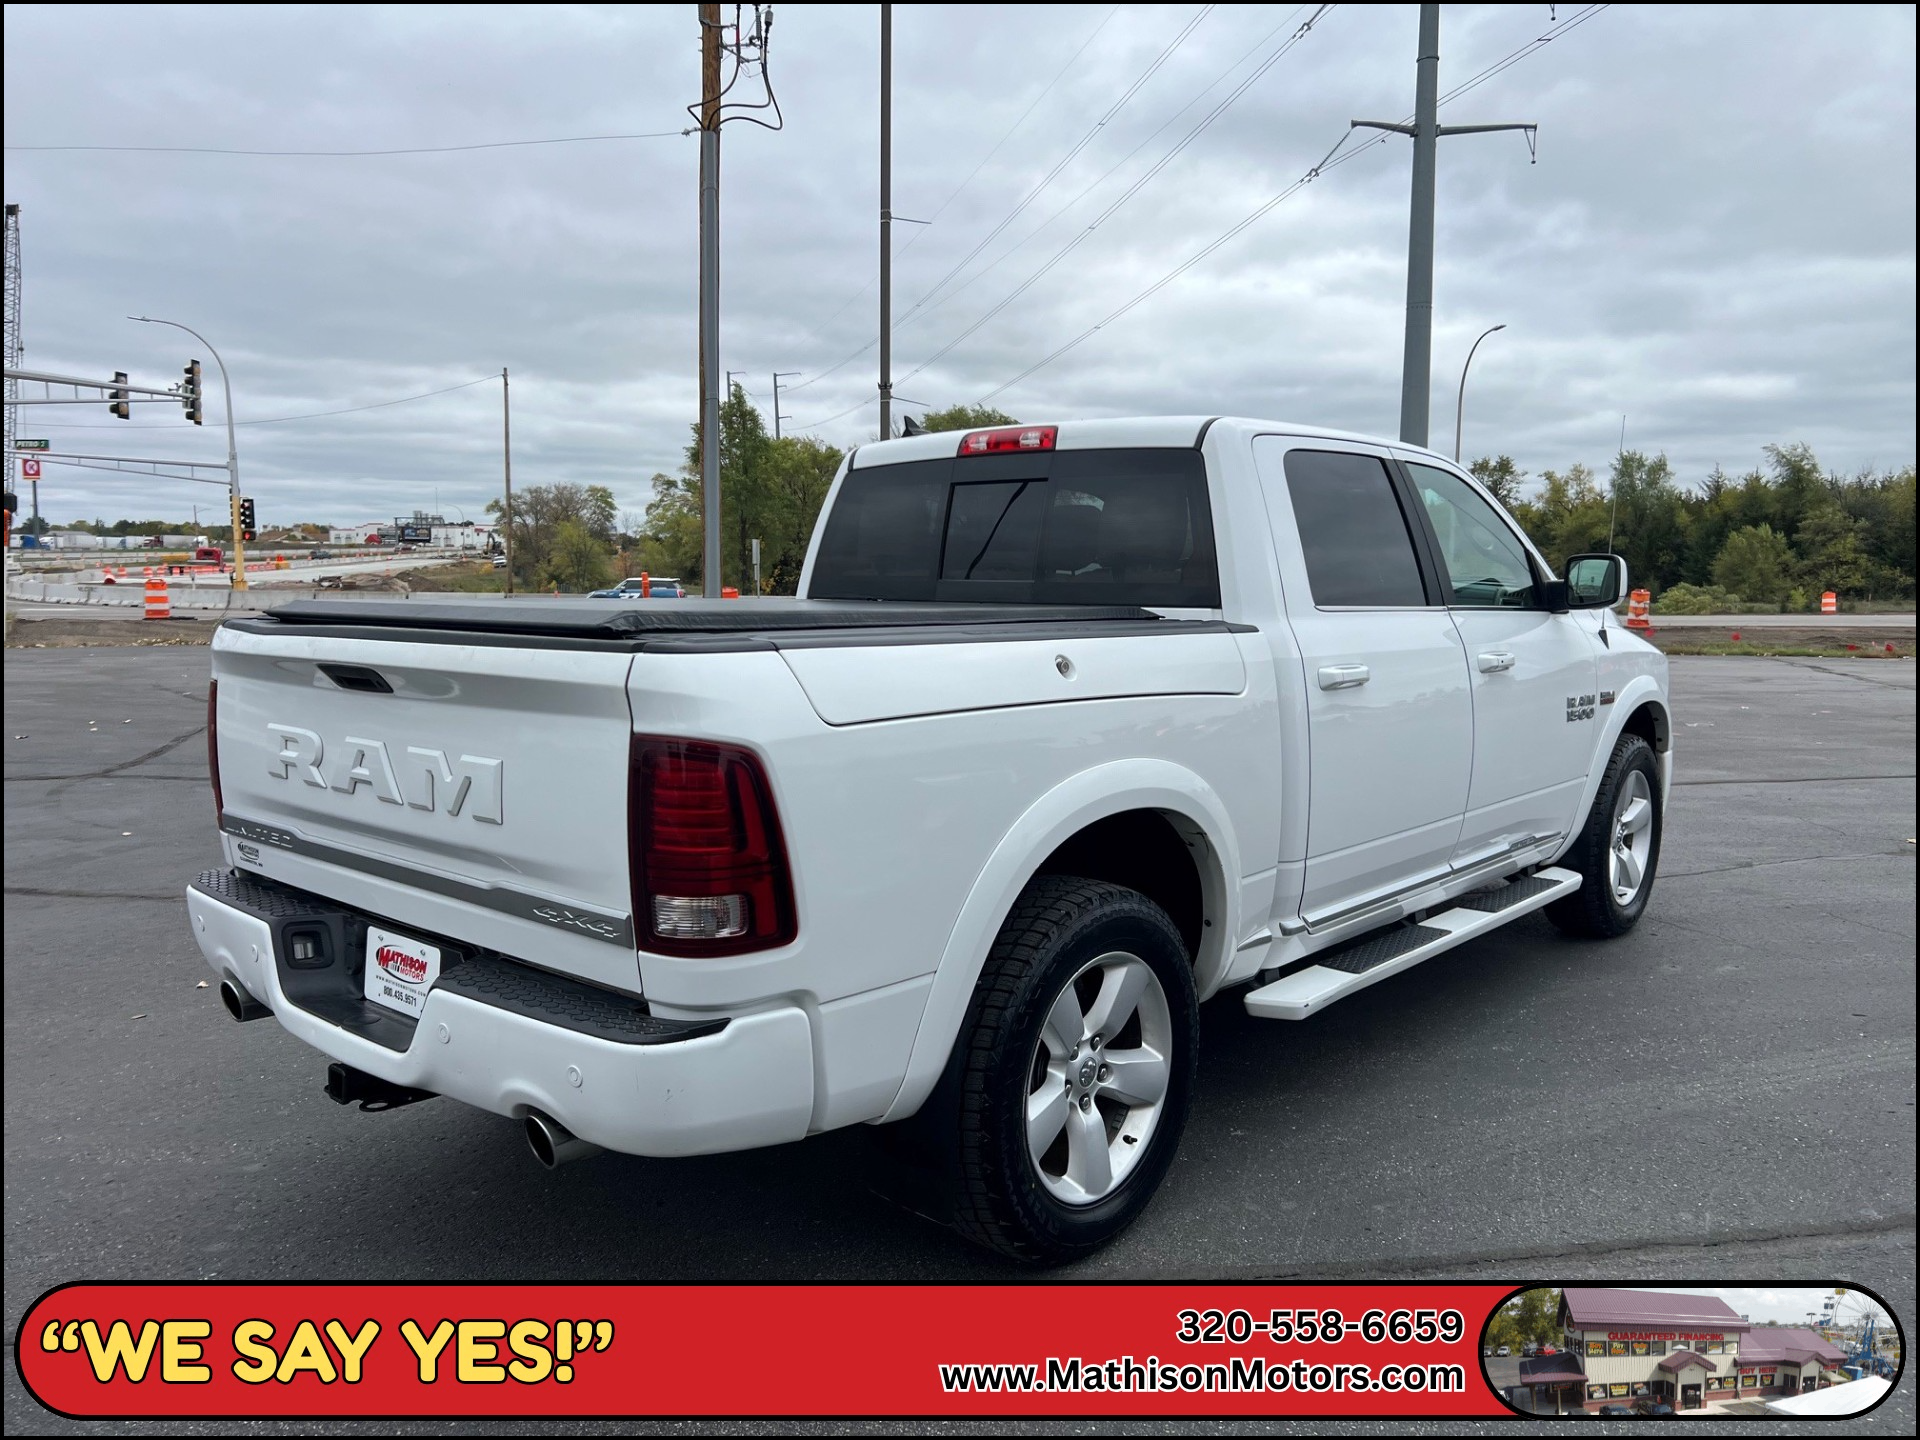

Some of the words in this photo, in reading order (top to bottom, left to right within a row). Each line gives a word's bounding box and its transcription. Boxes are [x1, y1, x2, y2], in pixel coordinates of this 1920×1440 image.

[1566, 695, 1596, 709] RAM
[1566, 706, 1595, 722] 1500
[267, 723, 503, 825] RAM
[378, 946, 428, 974] MATHISON
[399, 966, 425, 981] MOTORS
